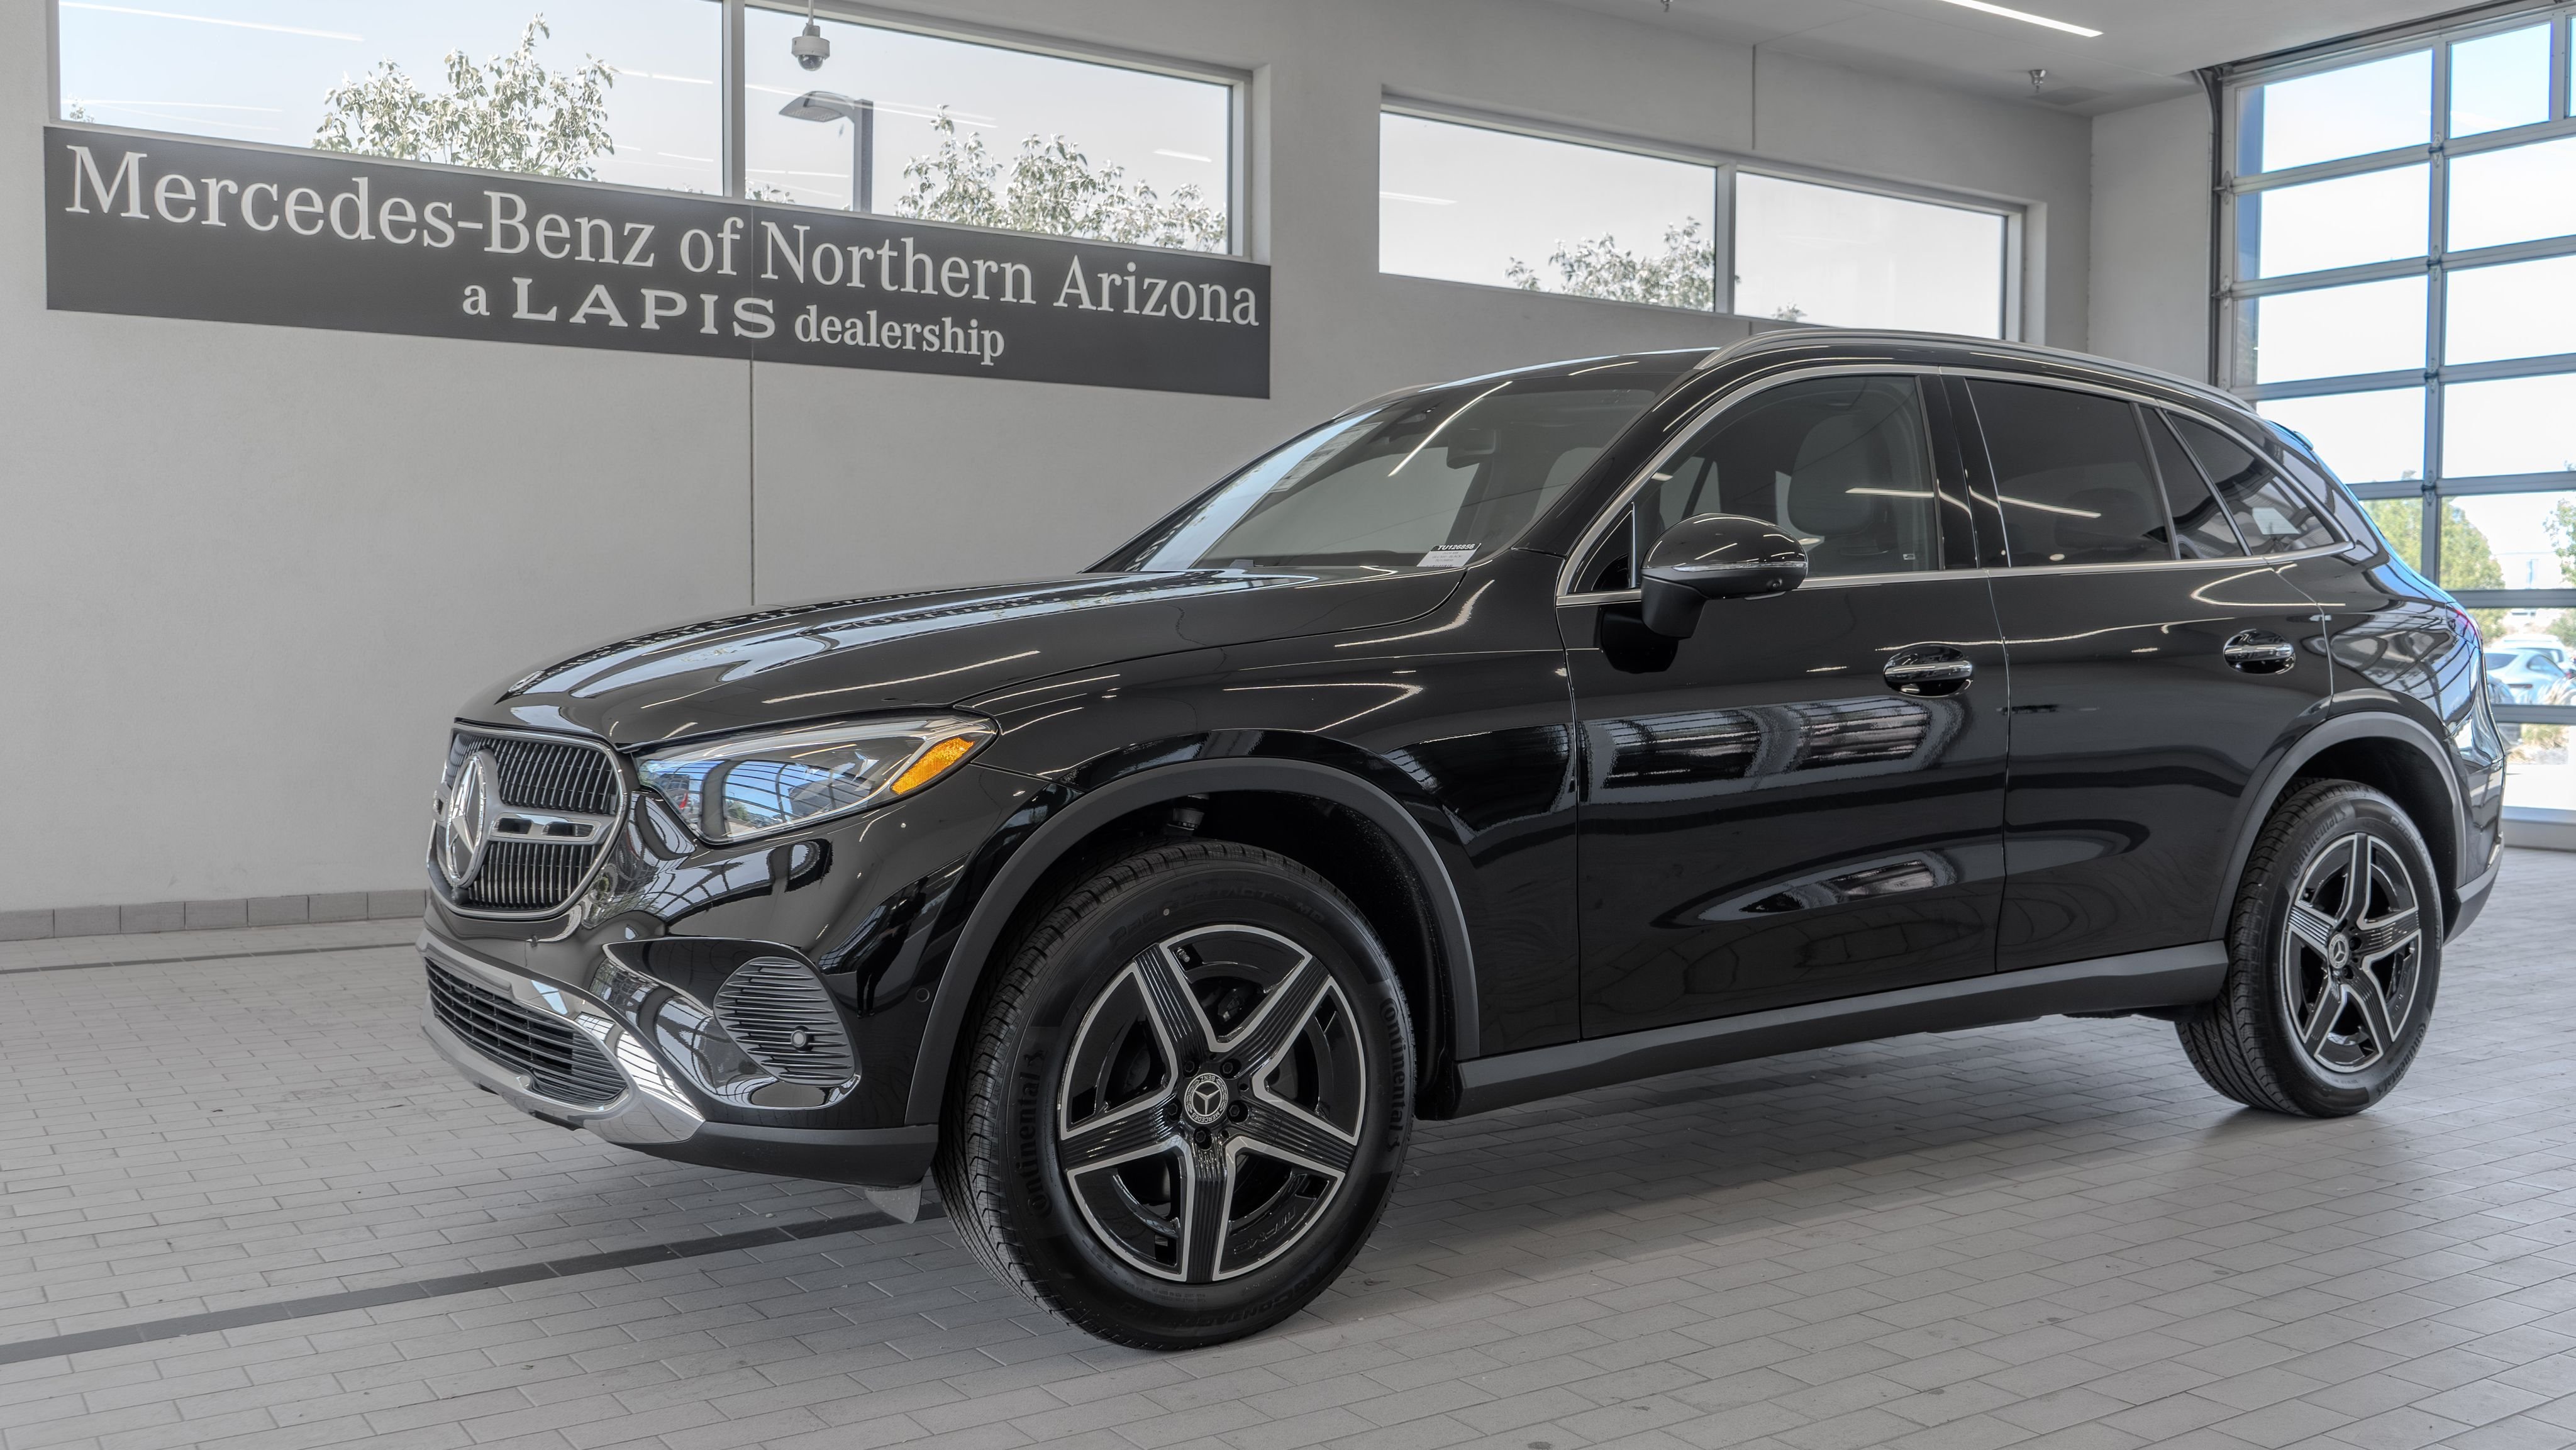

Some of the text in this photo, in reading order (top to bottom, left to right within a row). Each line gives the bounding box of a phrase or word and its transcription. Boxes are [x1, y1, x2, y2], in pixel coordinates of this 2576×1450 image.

[65, 145, 1258, 326] Mercedes-Benz of Northern Arizona
[463, 277, 1004, 365] a LAPIS dealership
[1191, 1111, 1220, 1123] MERCEDES
[1380, 998, 1406, 1131] Continental
[1018, 1071, 1053, 1219] Continental
